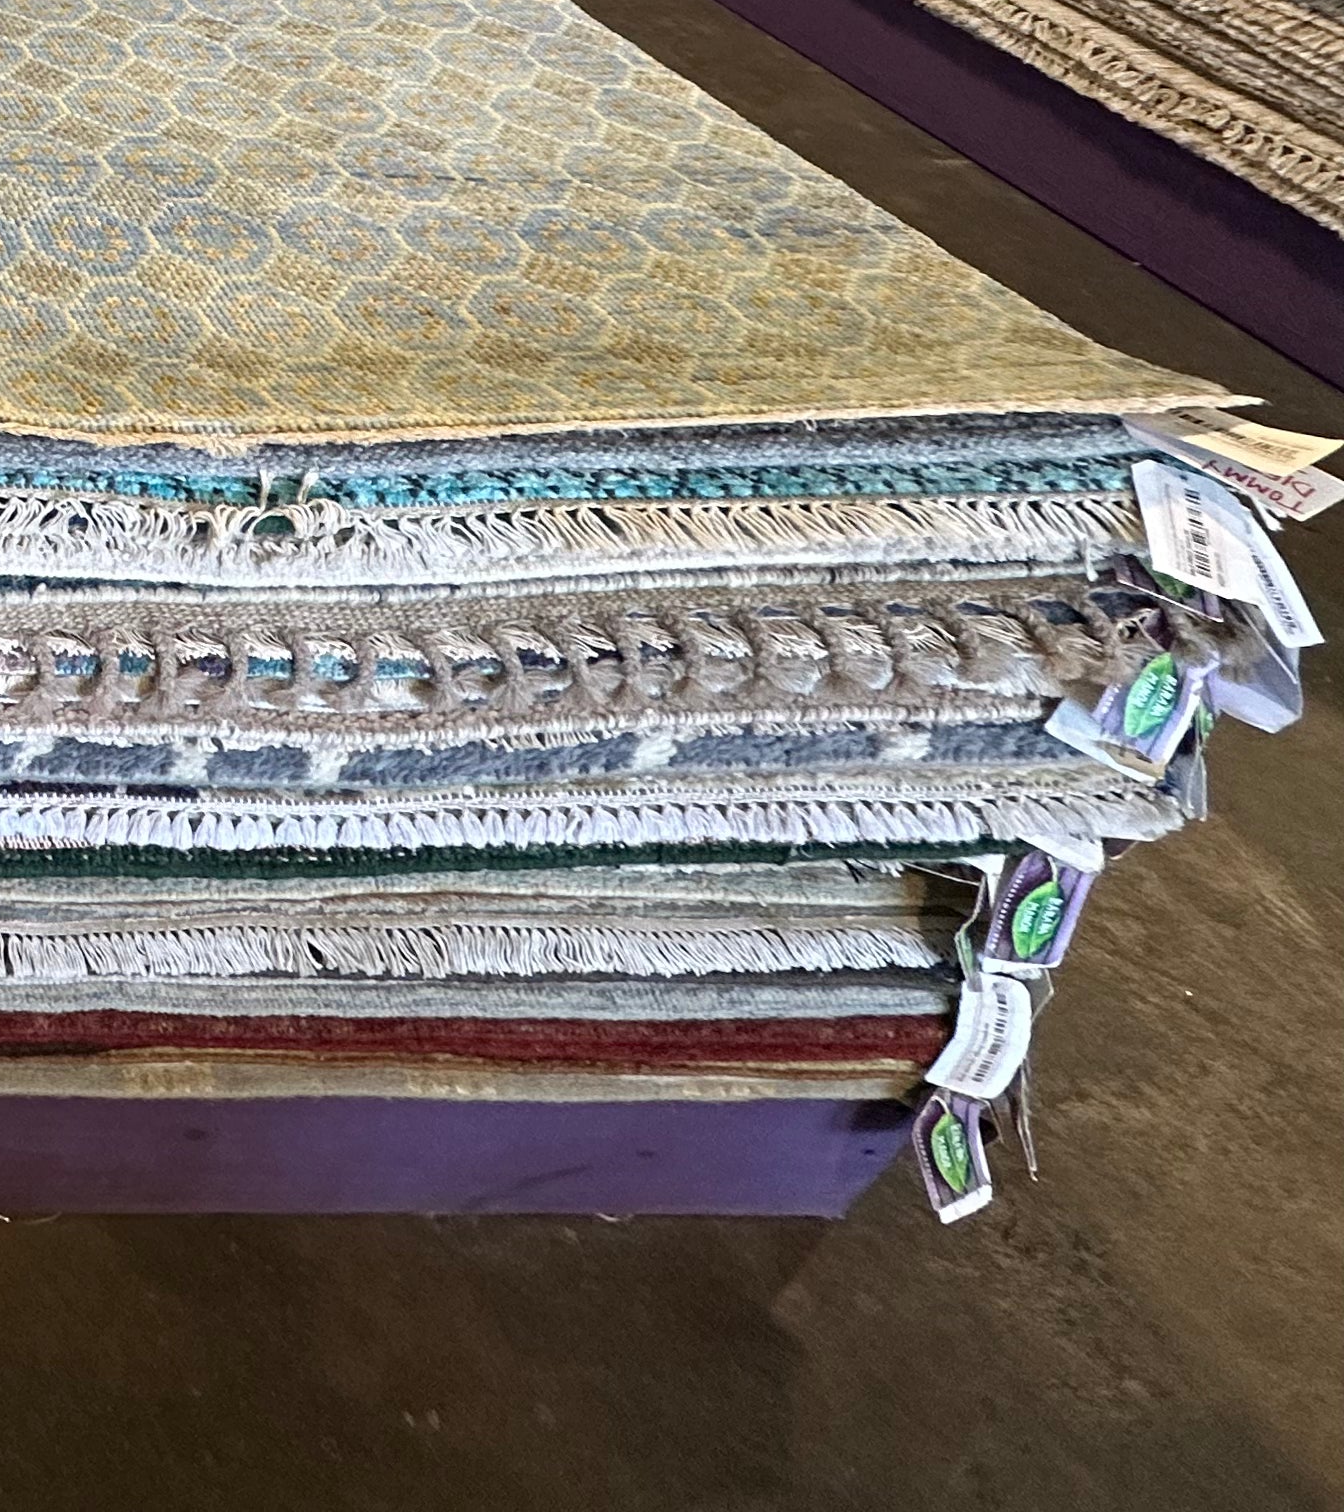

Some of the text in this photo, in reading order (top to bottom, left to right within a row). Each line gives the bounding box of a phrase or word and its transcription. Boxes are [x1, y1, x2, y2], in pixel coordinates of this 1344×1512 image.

[1201, 460, 1305, 515] TOMMY
[1150, 675, 1178, 716] BANANA
[1037, 897, 1064, 935] BANANA
